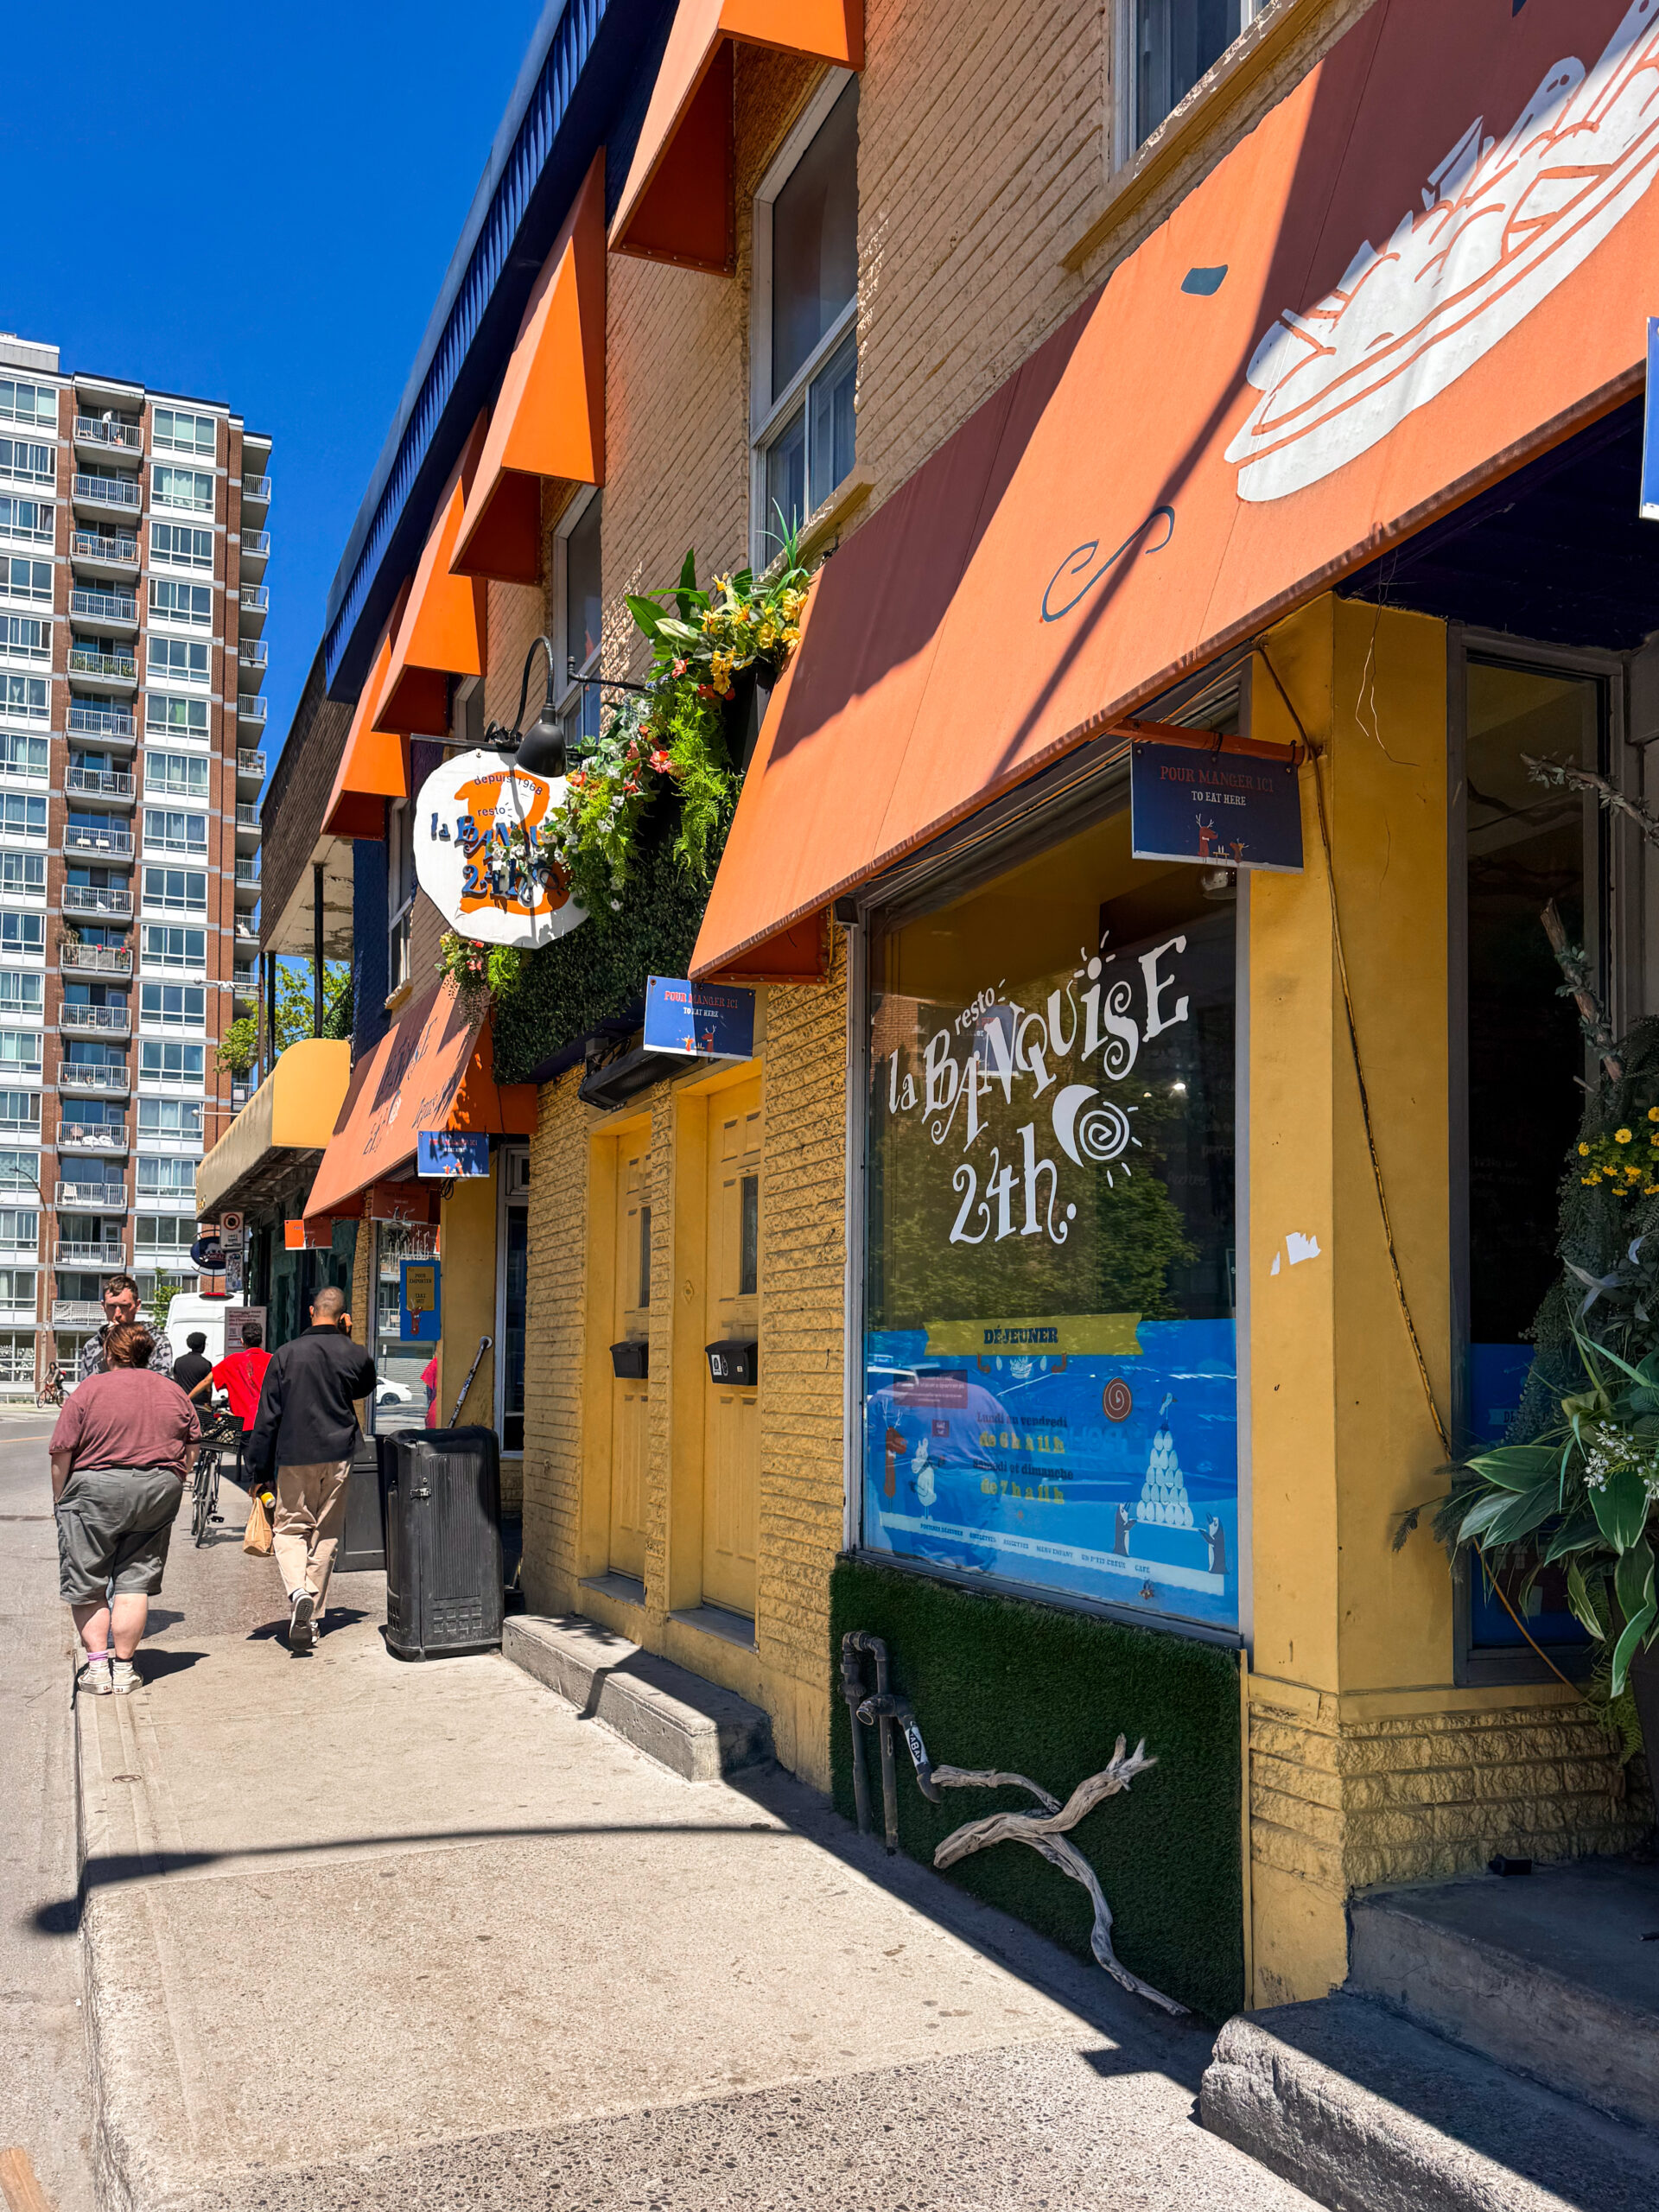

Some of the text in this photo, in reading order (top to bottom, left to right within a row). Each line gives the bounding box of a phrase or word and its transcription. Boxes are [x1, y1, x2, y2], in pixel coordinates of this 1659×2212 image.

[474, 773, 543, 796] depuis 1968
[1160, 766, 1274, 793] POUR MANGER ICI
[1192, 791, 1247, 806] TO EAT HERE
[477, 805, 506, 817] resto
[430, 812, 451, 842] la
[664, 990, 738, 1009] POUR MANGER ICI
[683, 1007, 719, 1018] TO EAT HERE
[954, 987, 995, 1037] resto
[888, 1049, 918, 1115] la
[983, 1324, 1058, 1345] DÉJEUNER
[1020, 1415, 1068, 1428] vendredi
[1009, 1463, 1020, 1474] et
[1021, 1464, 1074, 1481] dimanche
[980, 1478, 998, 1496] de
